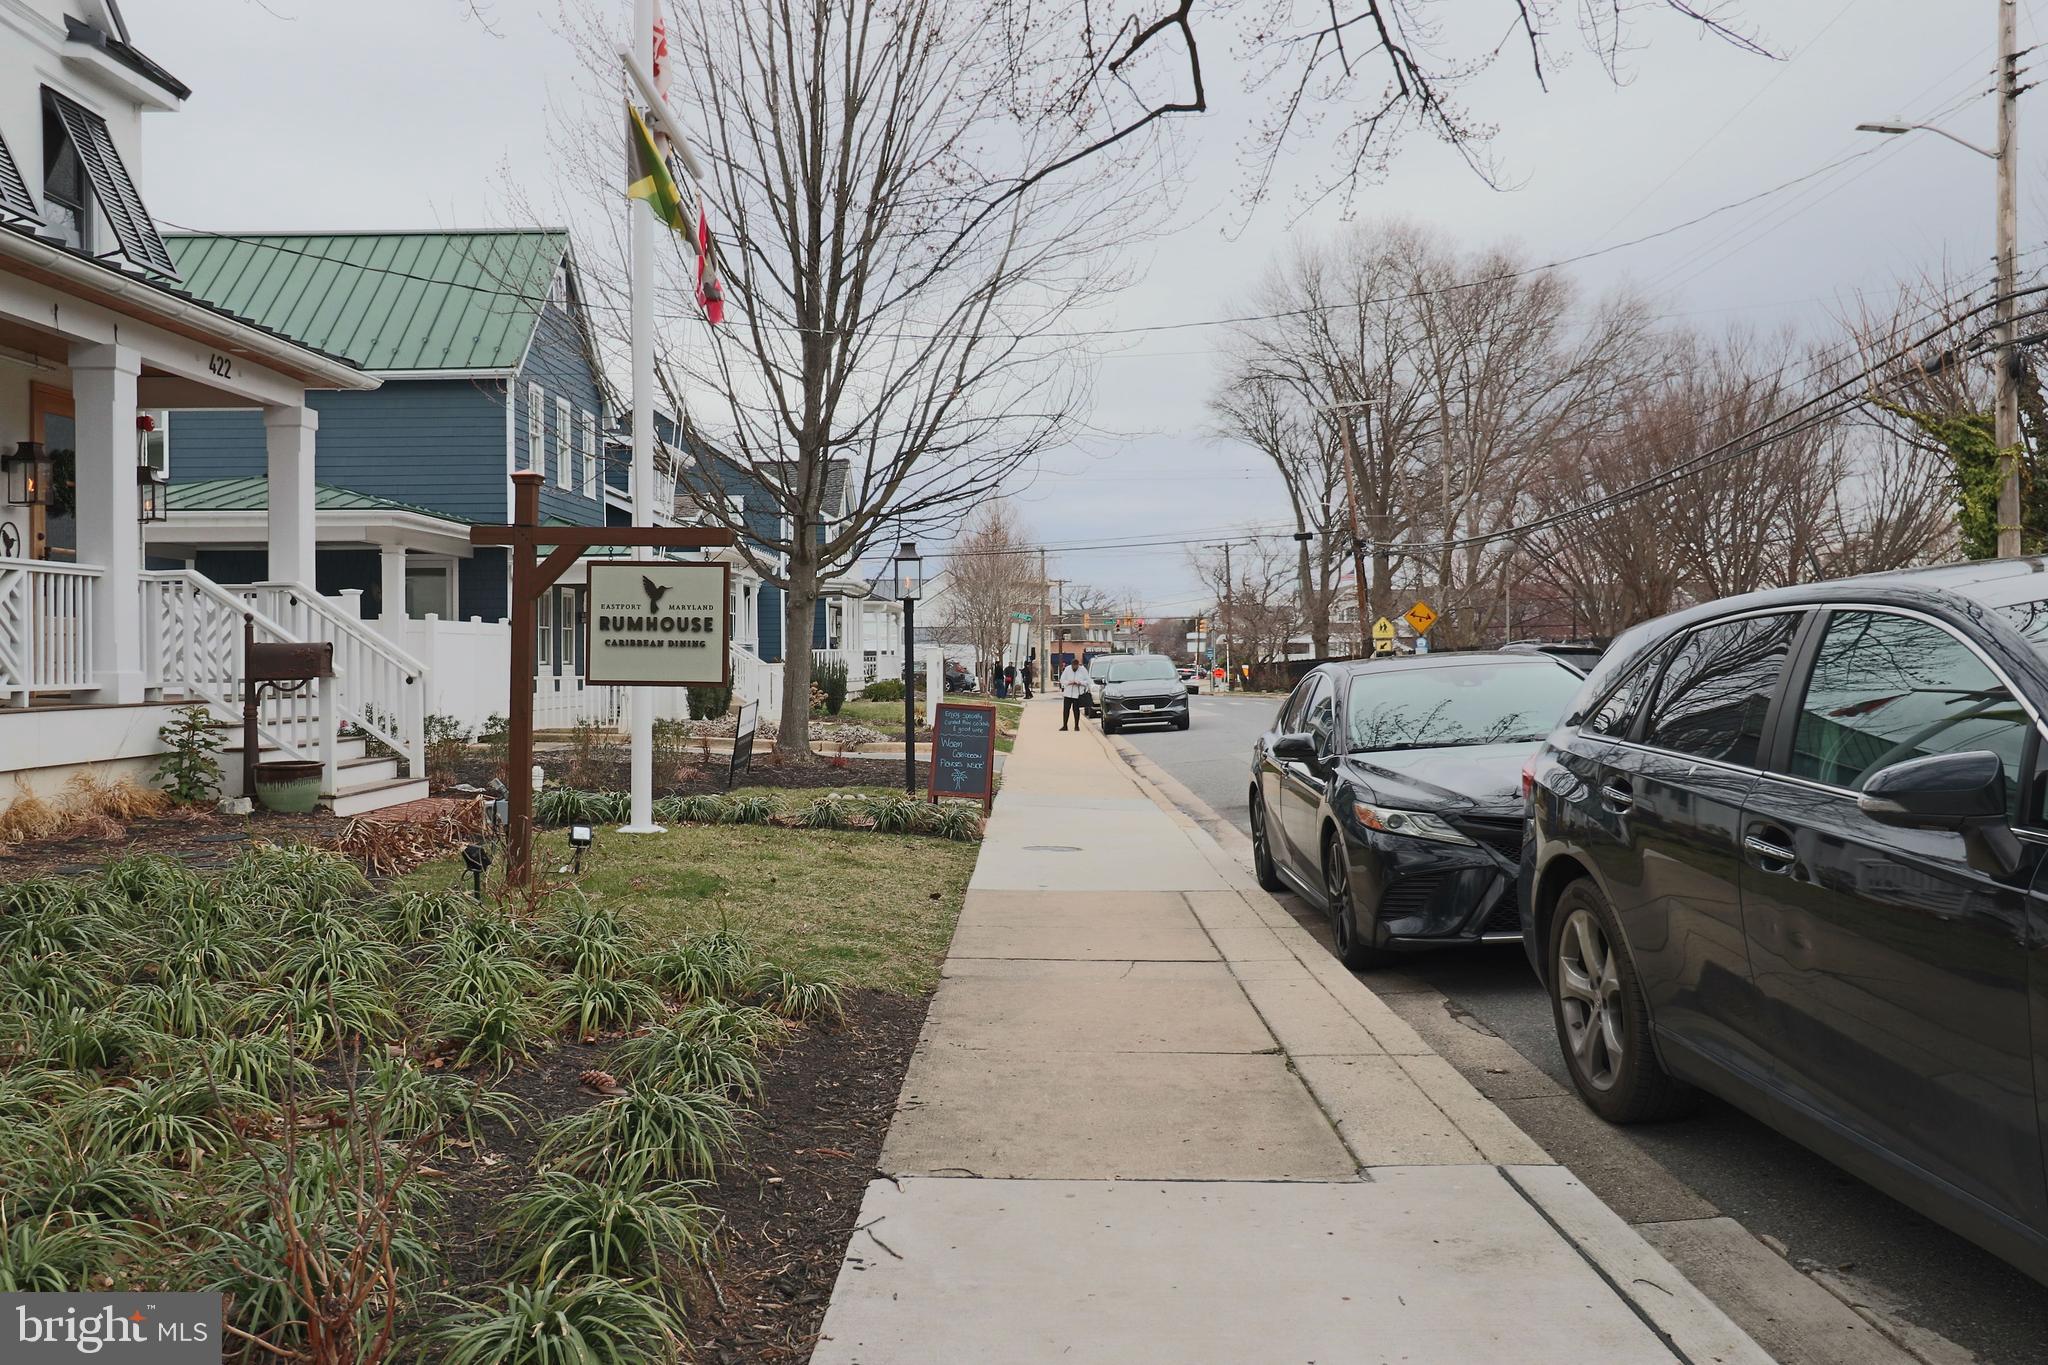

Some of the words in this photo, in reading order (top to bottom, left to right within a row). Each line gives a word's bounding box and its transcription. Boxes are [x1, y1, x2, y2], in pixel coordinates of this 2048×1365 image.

[209, 354, 231, 379] 422
[599, 616, 714, 632] RUMHOUSE
[604, 639, 664, 648] CARIBBEAN
[668, 640, 706, 648] DINING
